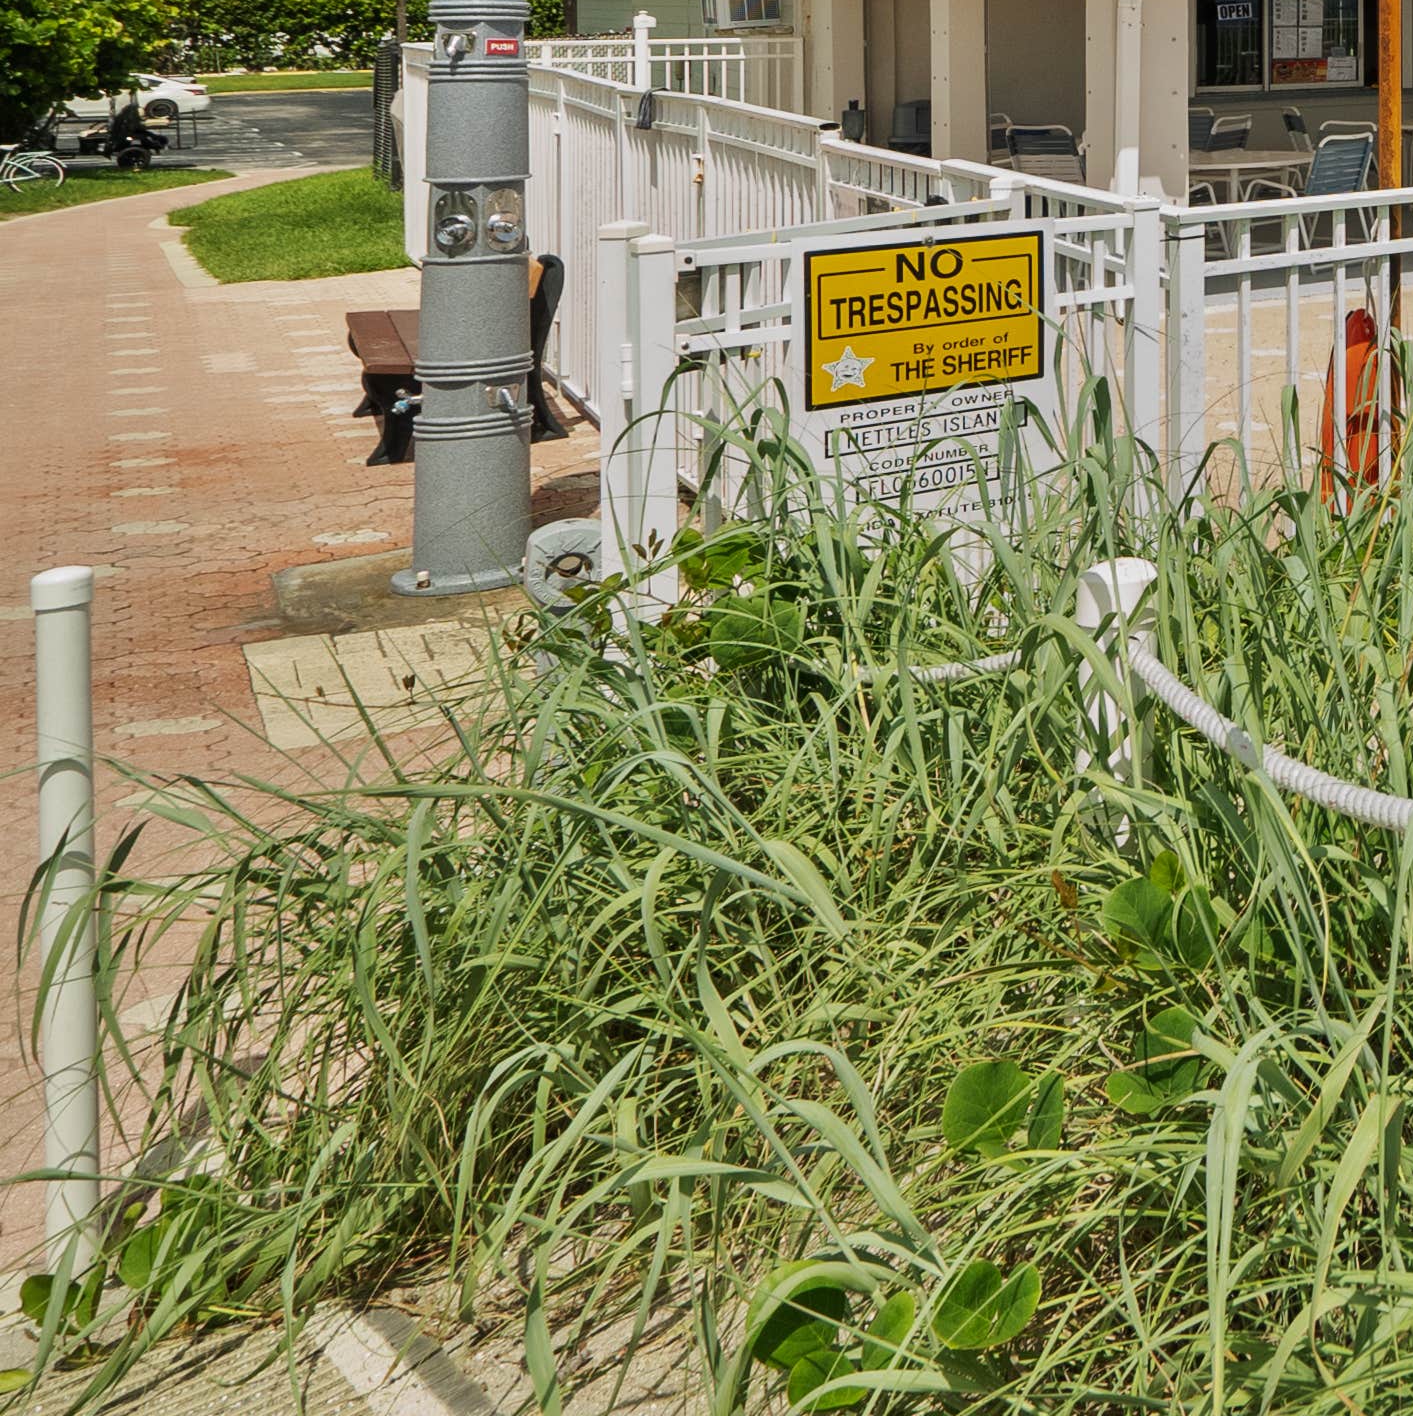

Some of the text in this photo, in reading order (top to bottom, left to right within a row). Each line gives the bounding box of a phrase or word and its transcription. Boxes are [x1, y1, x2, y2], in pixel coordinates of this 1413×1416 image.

[1219, 4, 1250, 19] OPEN
[896, 248, 963, 283] NO
[830, 279, 1023, 330] TRESPASSING
[913, 332, 1009, 355] By order of
[890, 345, 1033, 382] THE SHERIFF
[952, 390, 1015, 407] OWNER
[943, 411, 1004, 433] ISLAN
[869, 456, 917, 472] CODE
